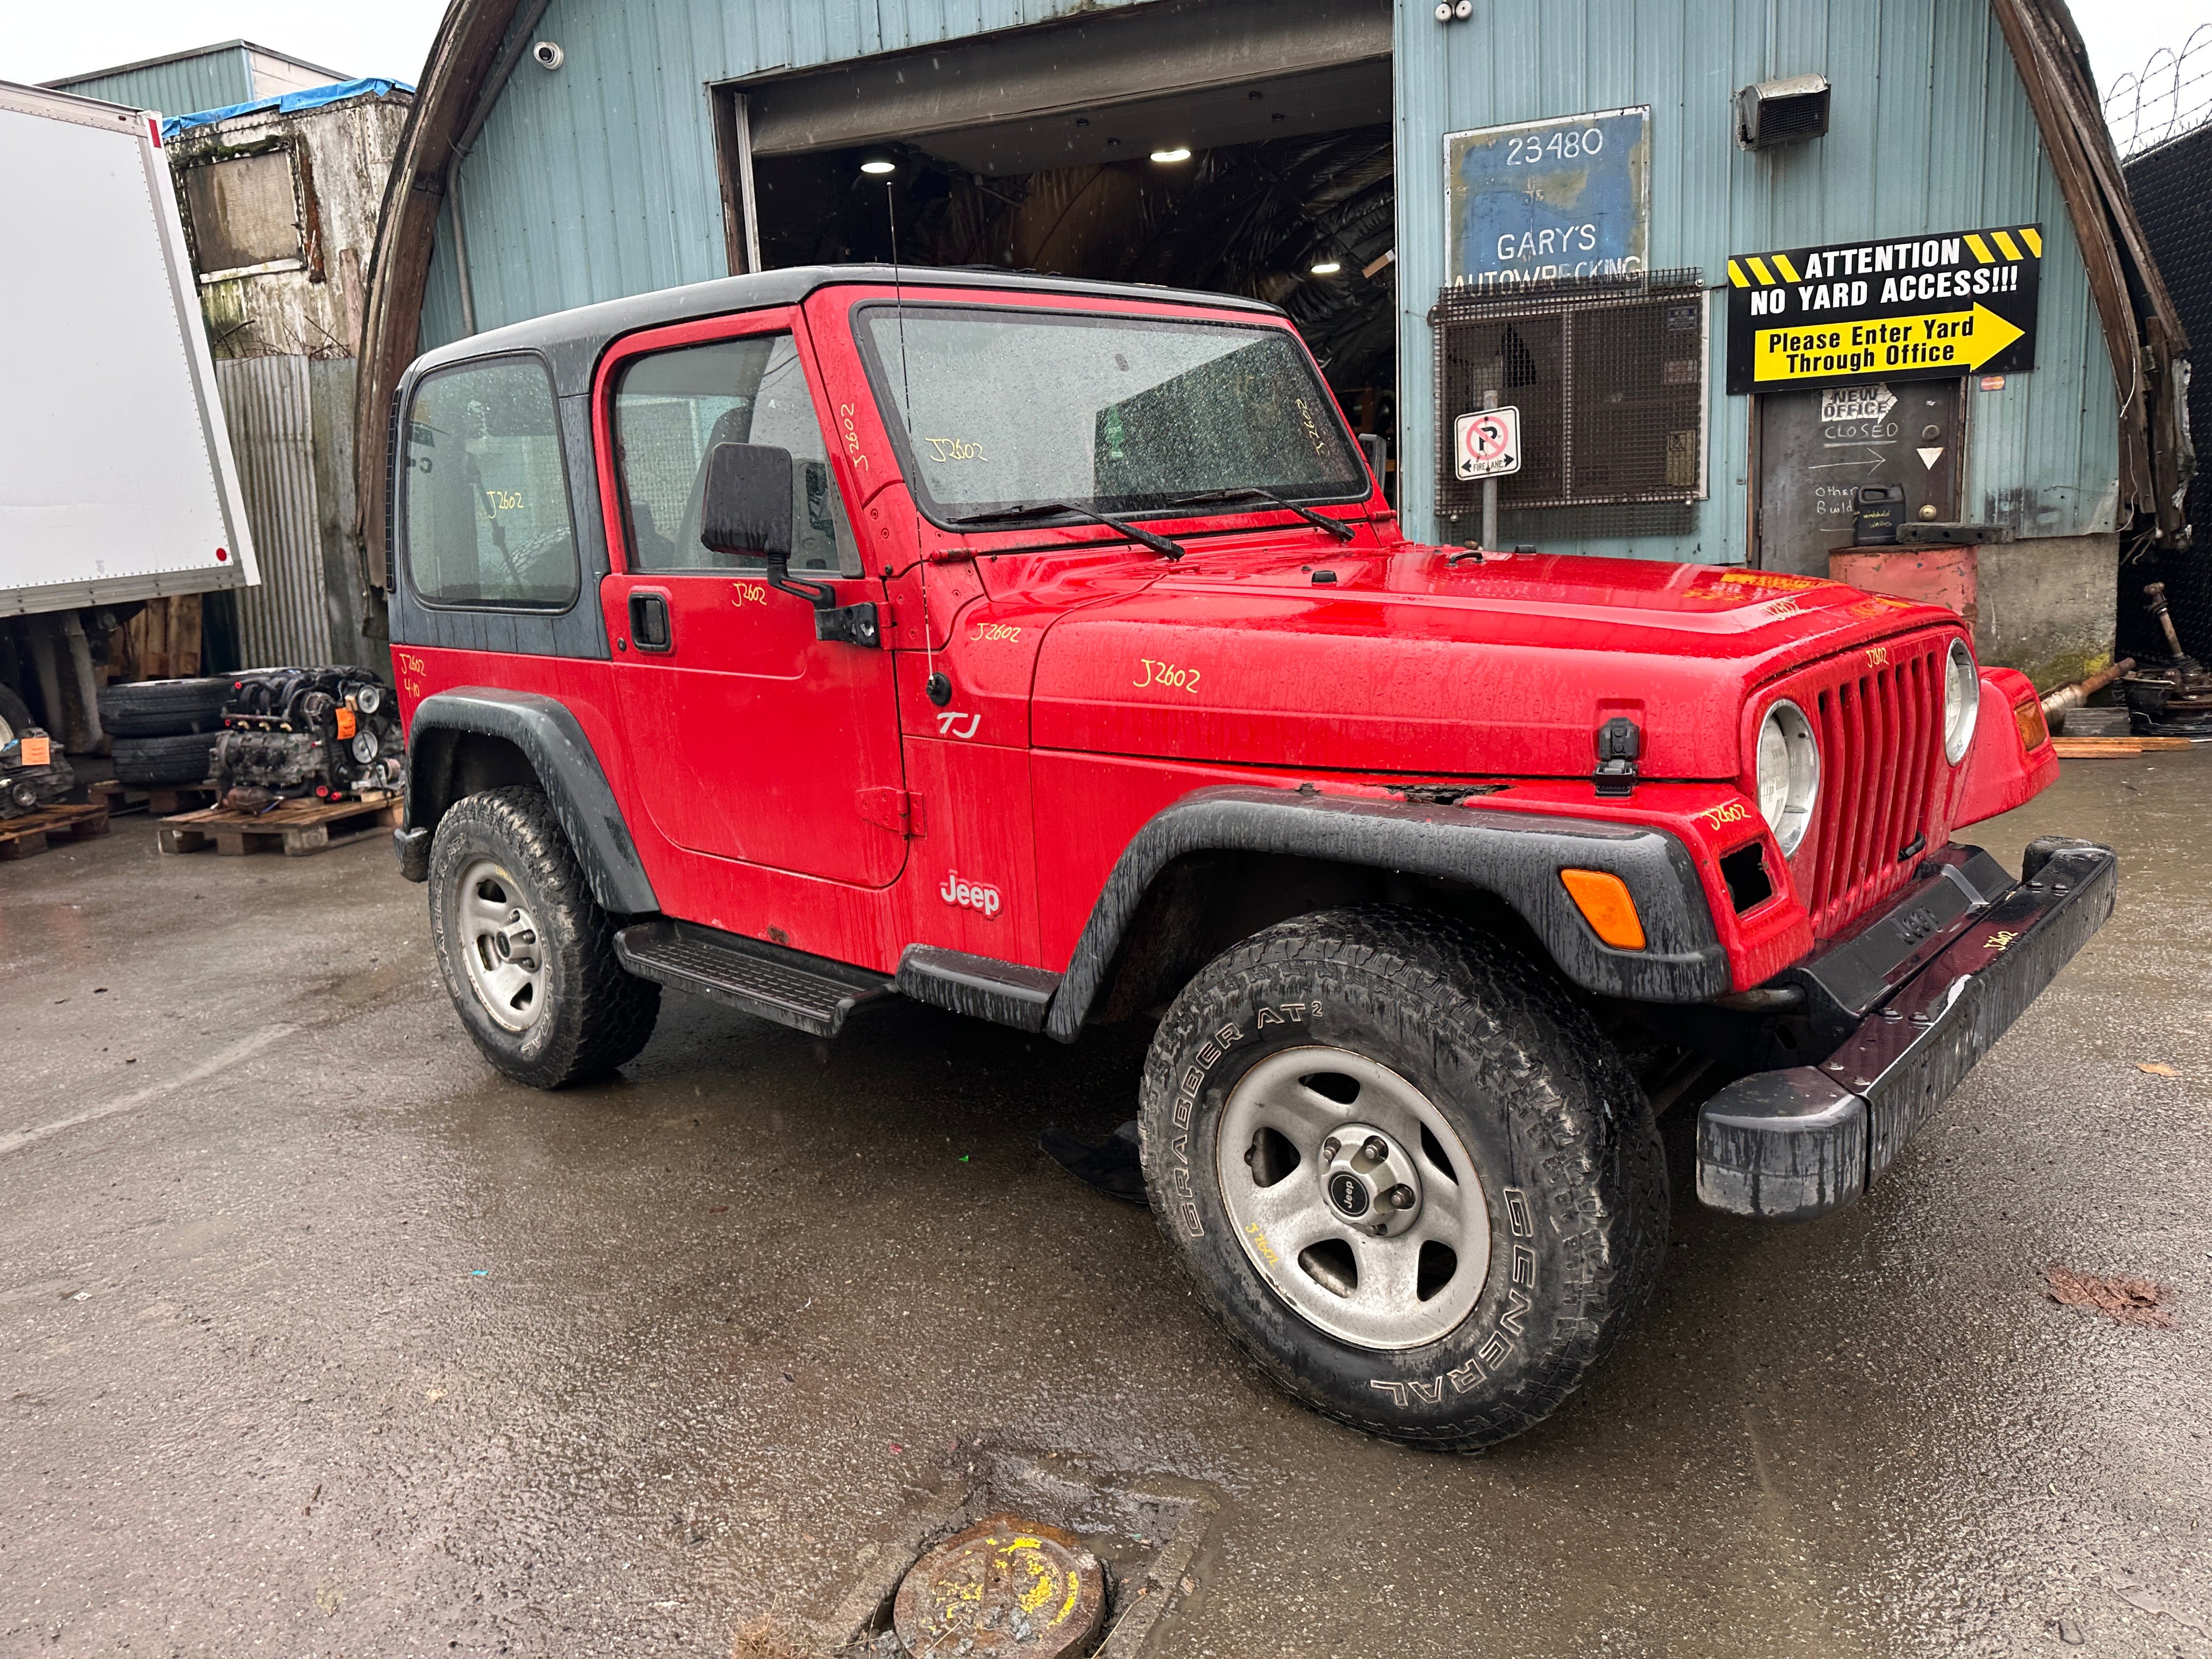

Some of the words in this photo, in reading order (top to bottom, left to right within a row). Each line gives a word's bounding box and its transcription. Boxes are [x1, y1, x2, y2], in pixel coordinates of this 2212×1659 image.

[1507, 128, 1604, 166] 23480
[1497, 224, 1596, 260] GARY'S
[1804, 238, 1960, 280] ATTENTION
[1751, 289, 1786, 316] NO
[1798, 281, 1868, 311] YARD
[1880, 265, 2018, 304] ACCESS!!!
[1769, 332, 1840, 353] Please
[1852, 323, 1912, 346] Enter
[1923, 316, 1974, 339] Yard
[1786, 347, 1874, 374] Through
[1887, 344, 1954, 365] Office
[1834, 388, 1877, 403] NEW
[1824, 402, 1887, 418] OFFICE
[841, 403, 869, 471] J2602
[1825, 422, 1898, 438] CLOSED
[925, 437, 988, 462] J2602
[1474, 463, 1486, 471] FIRE
[486, 491, 524, 518] J2602
[1816, 486, 1858, 497] Other
[731, 583, 767, 607] J2602
[970, 623, 1021, 643] J2602
[399, 653, 426, 677] J2602
[1865, 647, 1889, 668] J2602
[1132, 658, 1200, 694] J2602
[937, 711, 981, 738] TJ
[1700, 804, 1752, 831] J2602
[941, 874, 999, 915] Jeep
[1172, 1022, 1244, 1238] GRABBER
[1343, 1181, 1354, 1209] Jeep
[1370, 1186, 1536, 1407] GENERAL
